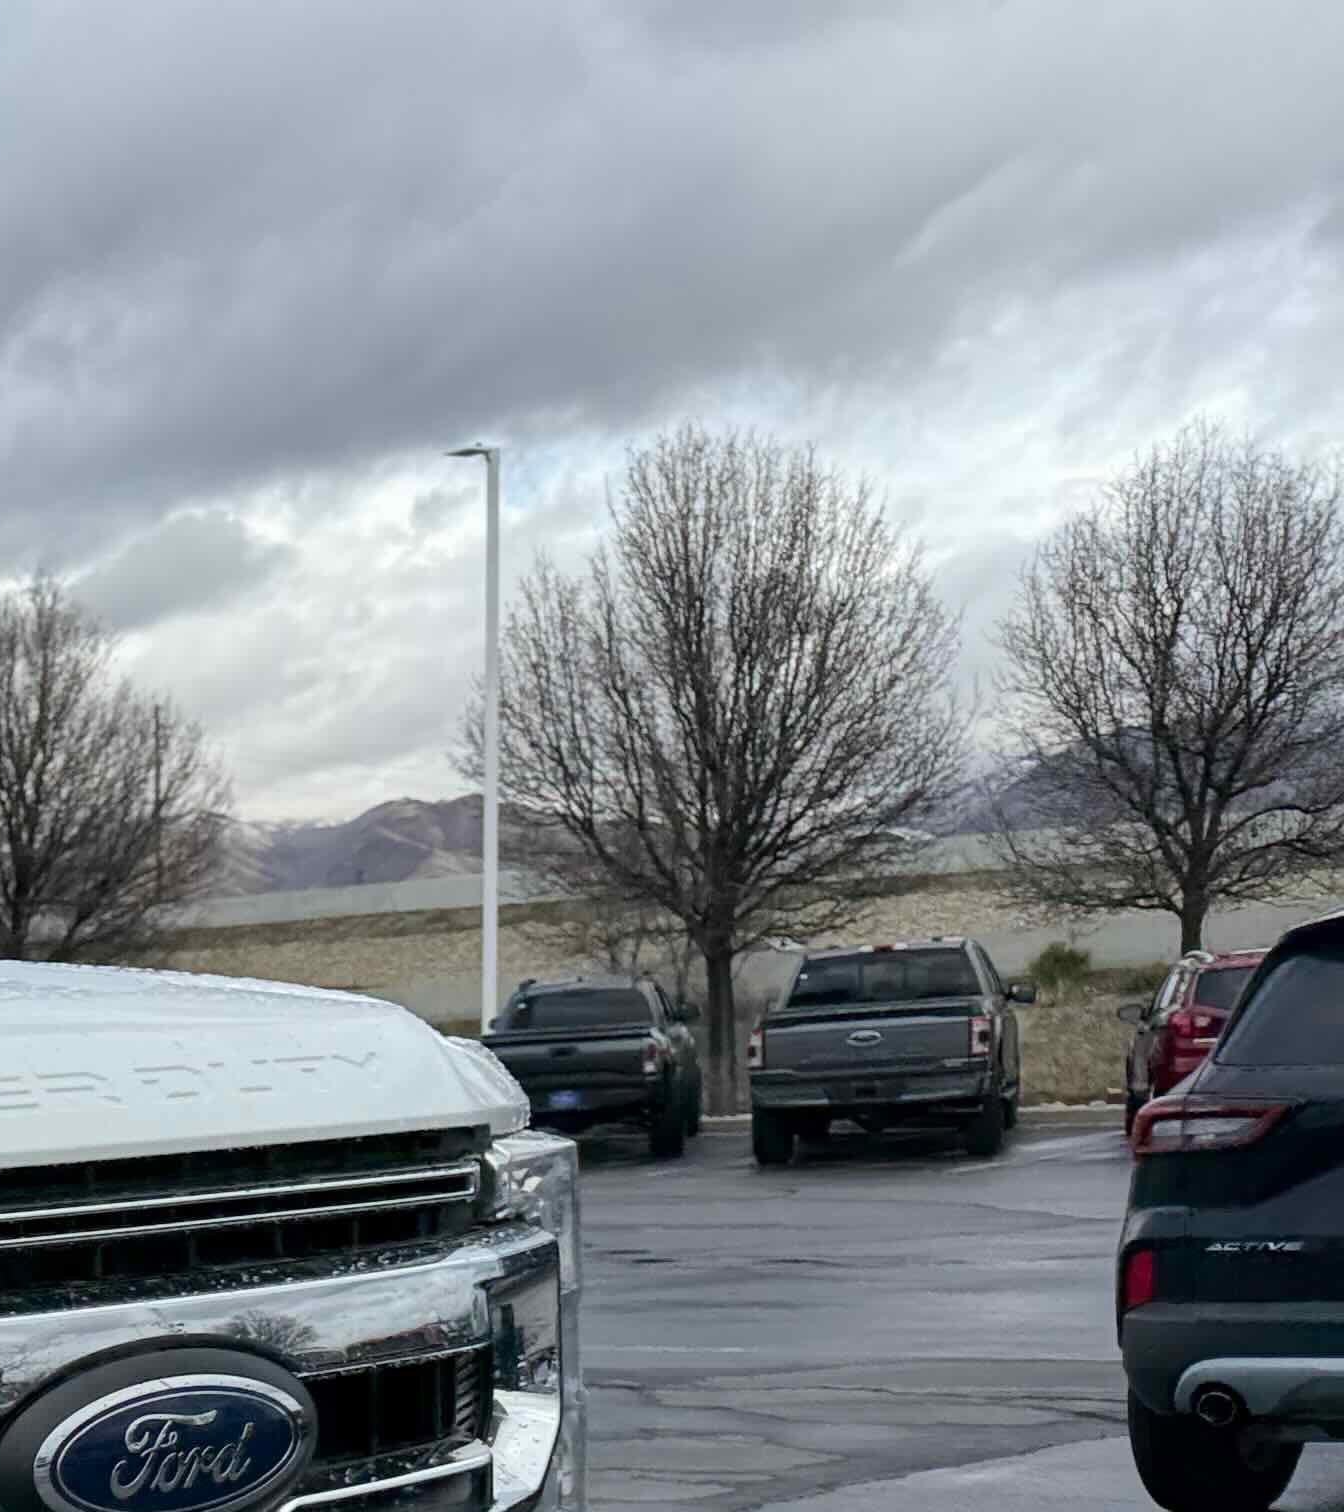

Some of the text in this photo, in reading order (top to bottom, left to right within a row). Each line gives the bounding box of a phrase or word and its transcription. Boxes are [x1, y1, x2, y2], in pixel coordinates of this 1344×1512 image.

[129, 1050, 380, 1104] DUTY
[1204, 1241, 1304, 1253] ACTIVE
[109, 1409, 255, 1499] Ford
